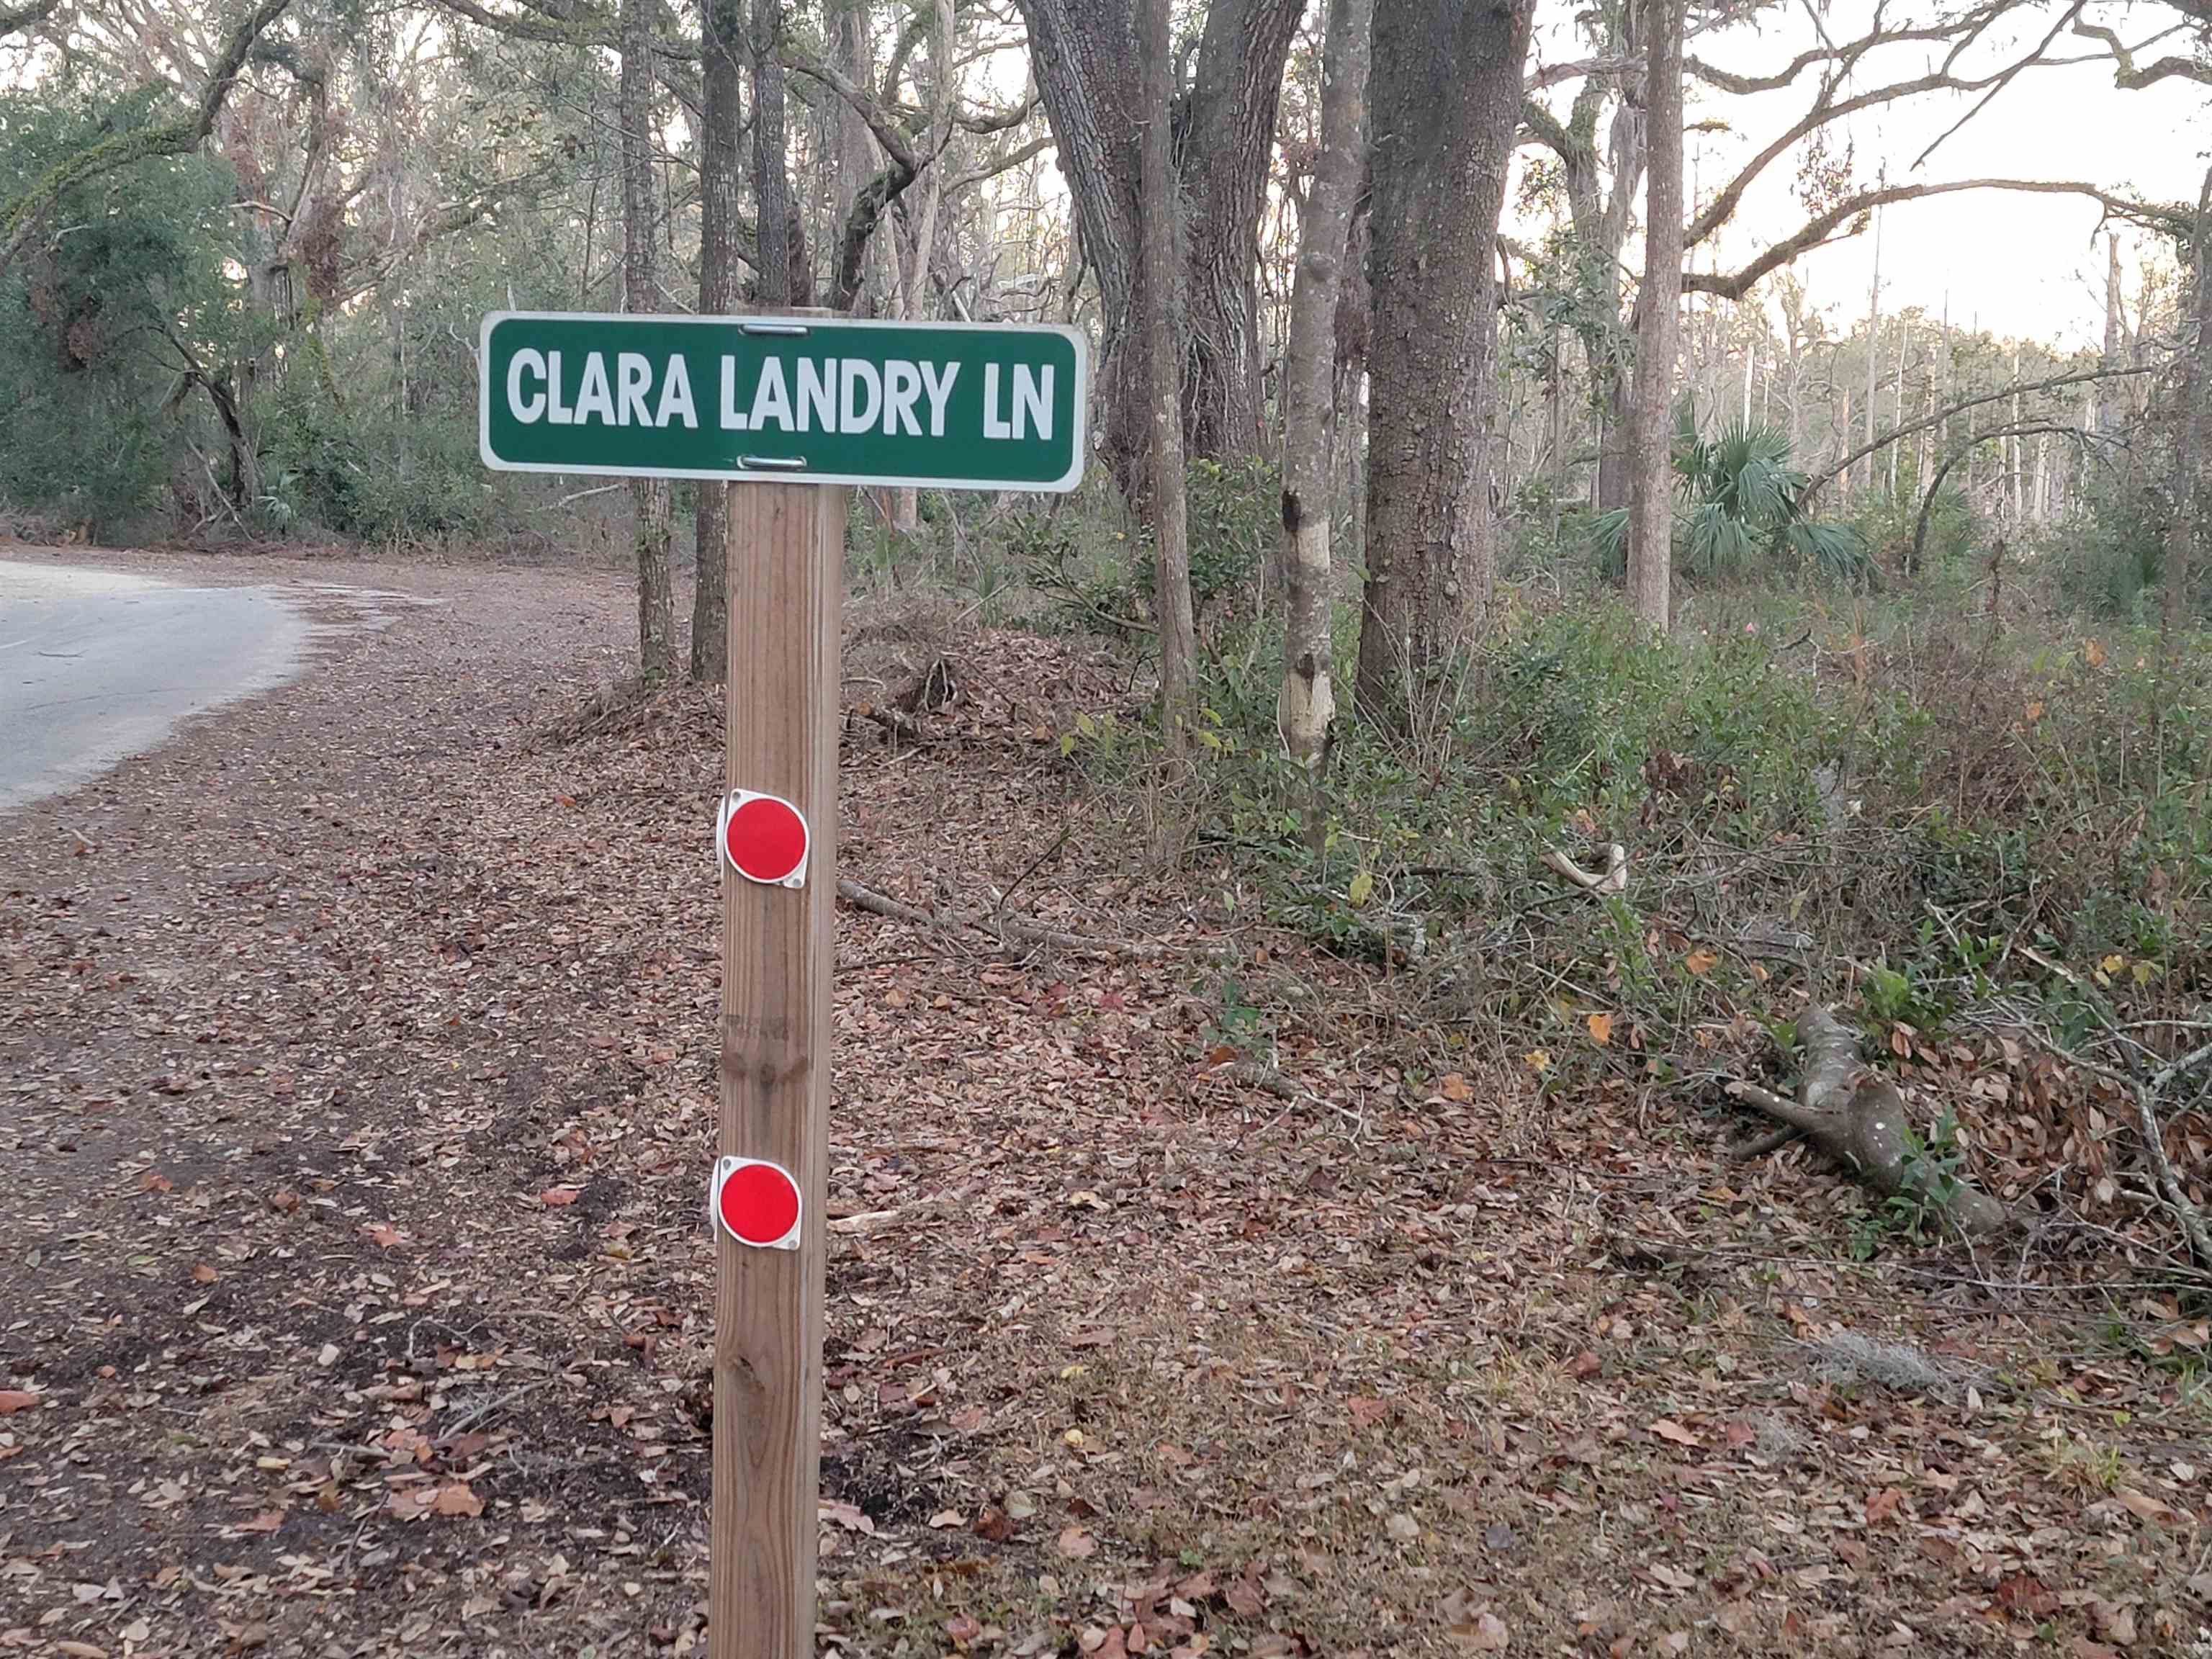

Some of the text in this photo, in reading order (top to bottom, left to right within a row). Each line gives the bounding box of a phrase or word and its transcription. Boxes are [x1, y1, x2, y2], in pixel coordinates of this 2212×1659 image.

[506, 348, 1055, 440] CLARA LANDRY LN
